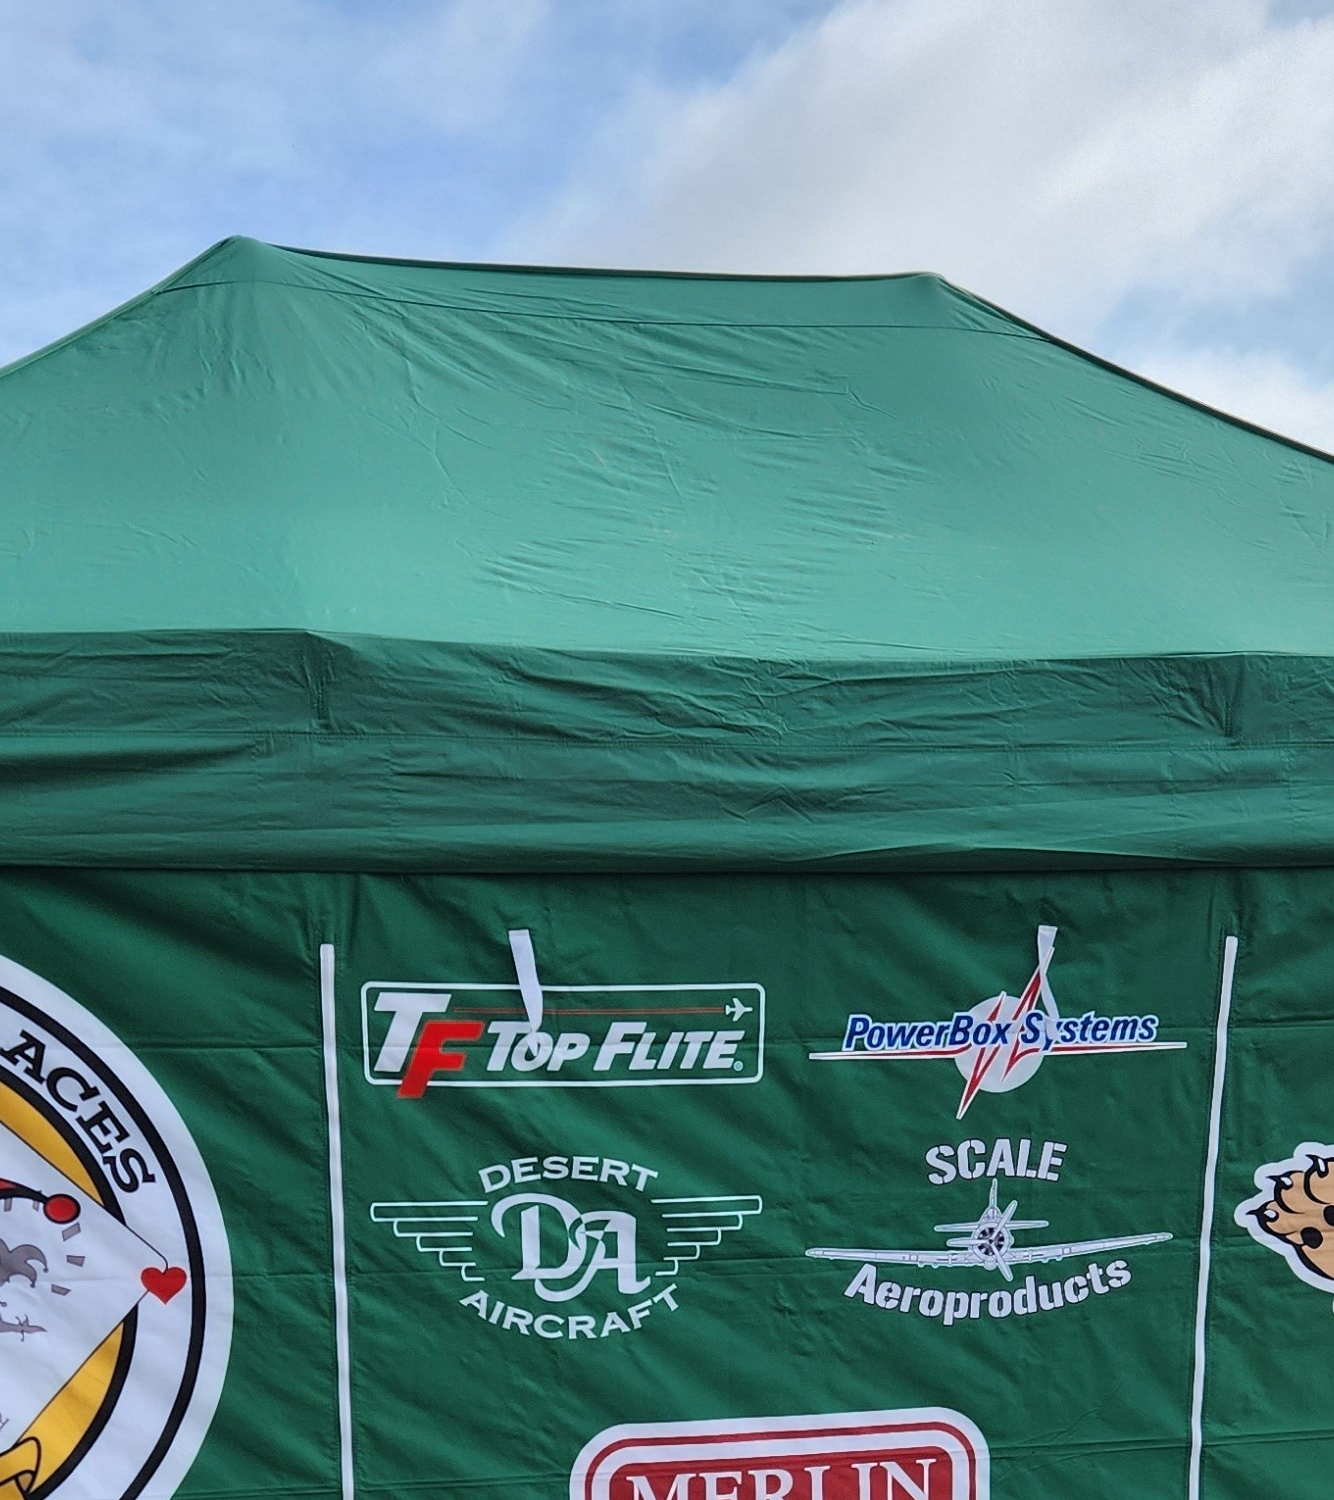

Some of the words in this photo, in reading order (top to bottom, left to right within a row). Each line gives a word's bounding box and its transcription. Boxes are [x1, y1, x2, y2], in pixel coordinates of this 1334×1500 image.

[486, 1021, 591, 1072] TOP
[844, 1013, 1012, 1050] PowerBox
[478, 1156, 659, 1193] DESERT
[925, 1138, 1068, 1185] SCALE
[459, 1283, 681, 1340] AIRCRAFT
[843, 1259, 1133, 1326] Aeroproducts
